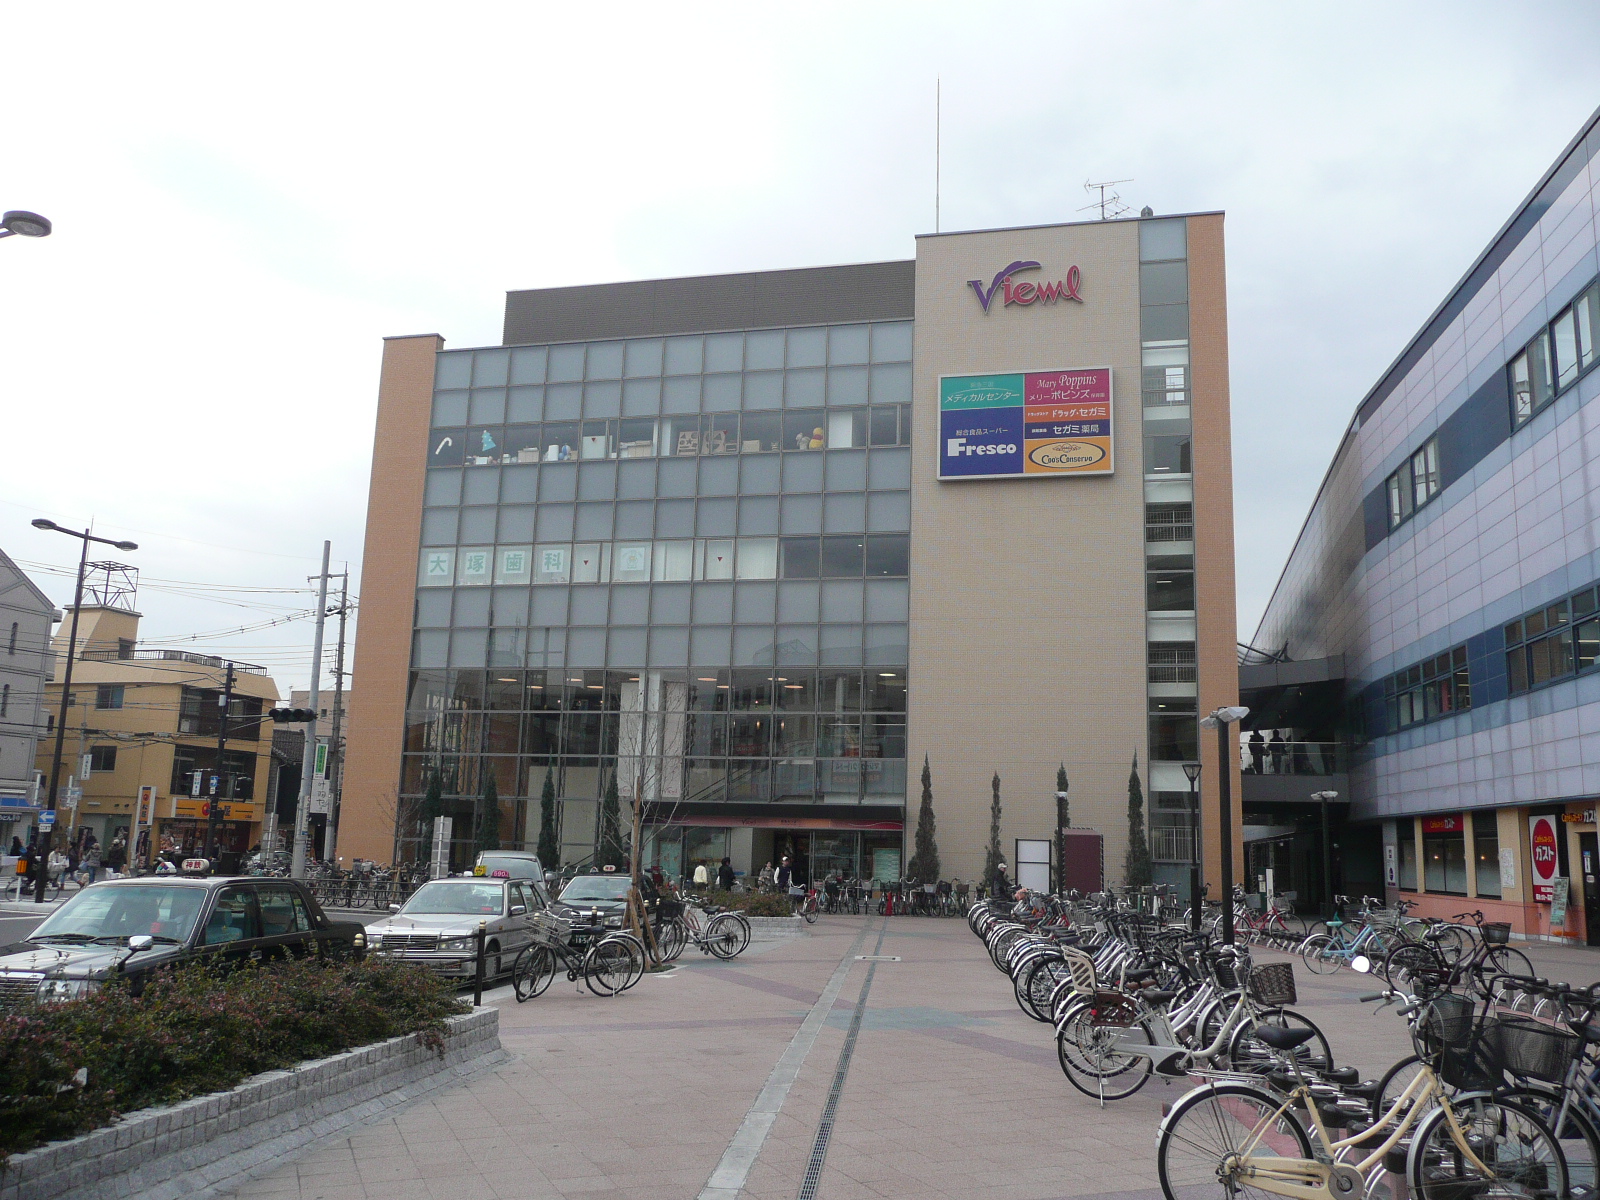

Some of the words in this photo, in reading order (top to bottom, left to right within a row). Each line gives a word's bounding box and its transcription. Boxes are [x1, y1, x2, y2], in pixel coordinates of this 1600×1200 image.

[1037, 380, 1057, 390] Mary
[1059, 373, 1097, 389] Poppins
[945, 391, 1020, 403] メディカルセンター
[1029, 389, 1090, 401] メリーポピンズ
[956, 427, 1009, 436] 総合食品スーパー
[947, 438, 1017, 456] Fresco
[430, 551, 562, 573] 大塚歯科
[1536, 845, 1554, 861] ガスト
